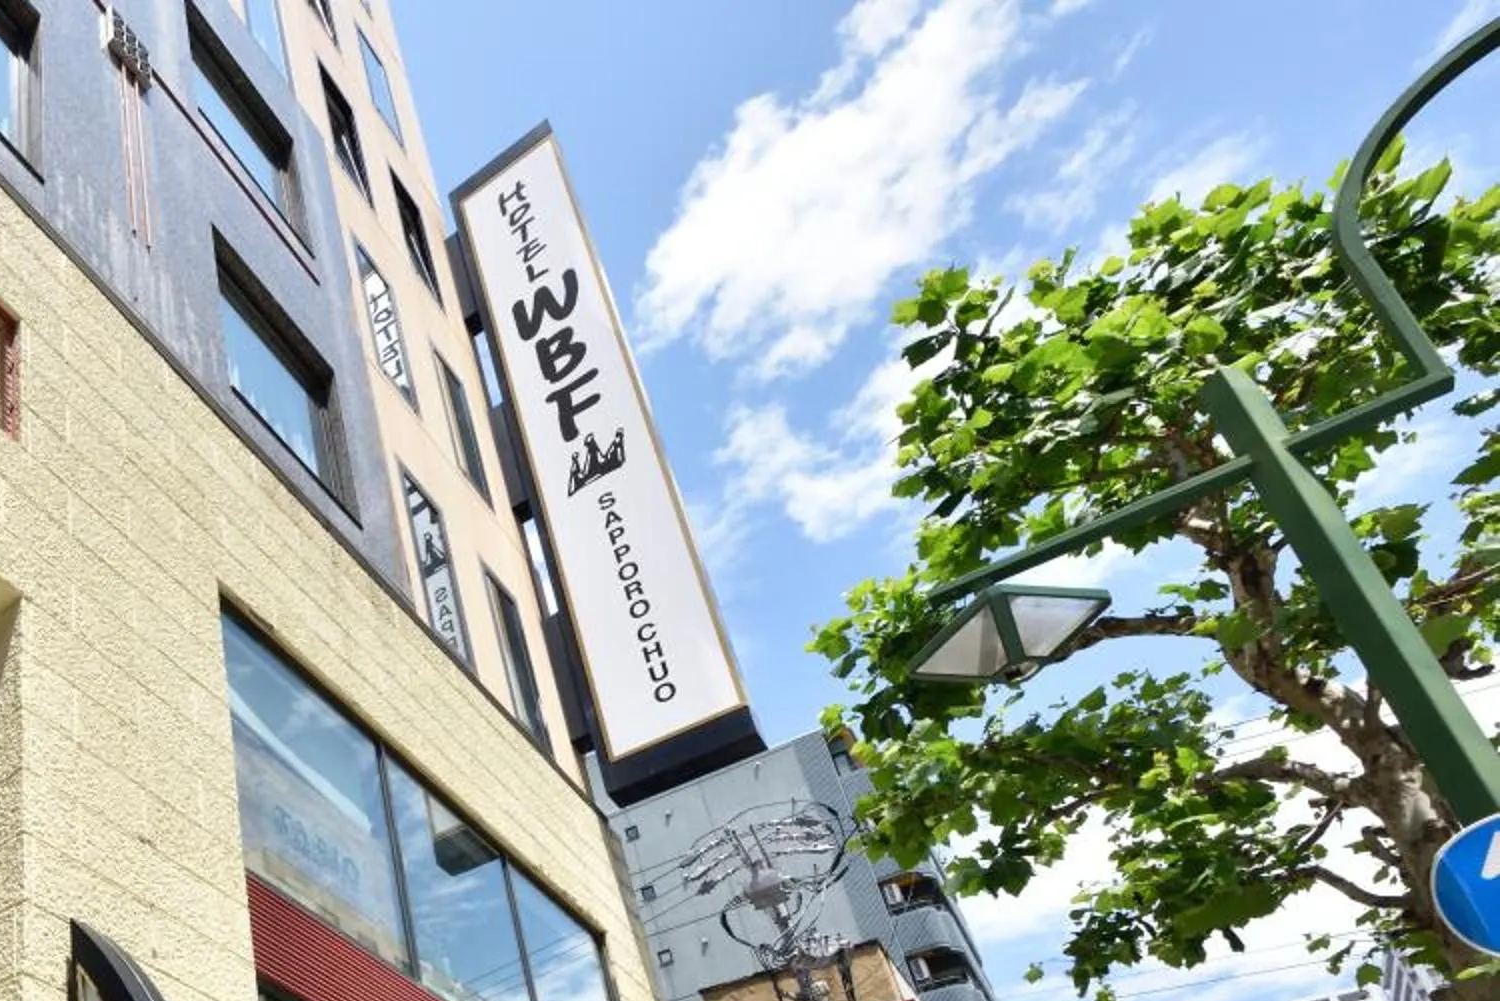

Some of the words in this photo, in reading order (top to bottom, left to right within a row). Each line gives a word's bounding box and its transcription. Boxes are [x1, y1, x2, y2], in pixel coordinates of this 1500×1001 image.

[498, 180, 549, 283] HOTEL
[512, 268, 601, 442] WBF
[598, 492, 650, 619] SAPPORO
[637, 623, 676, 703] CHUO
